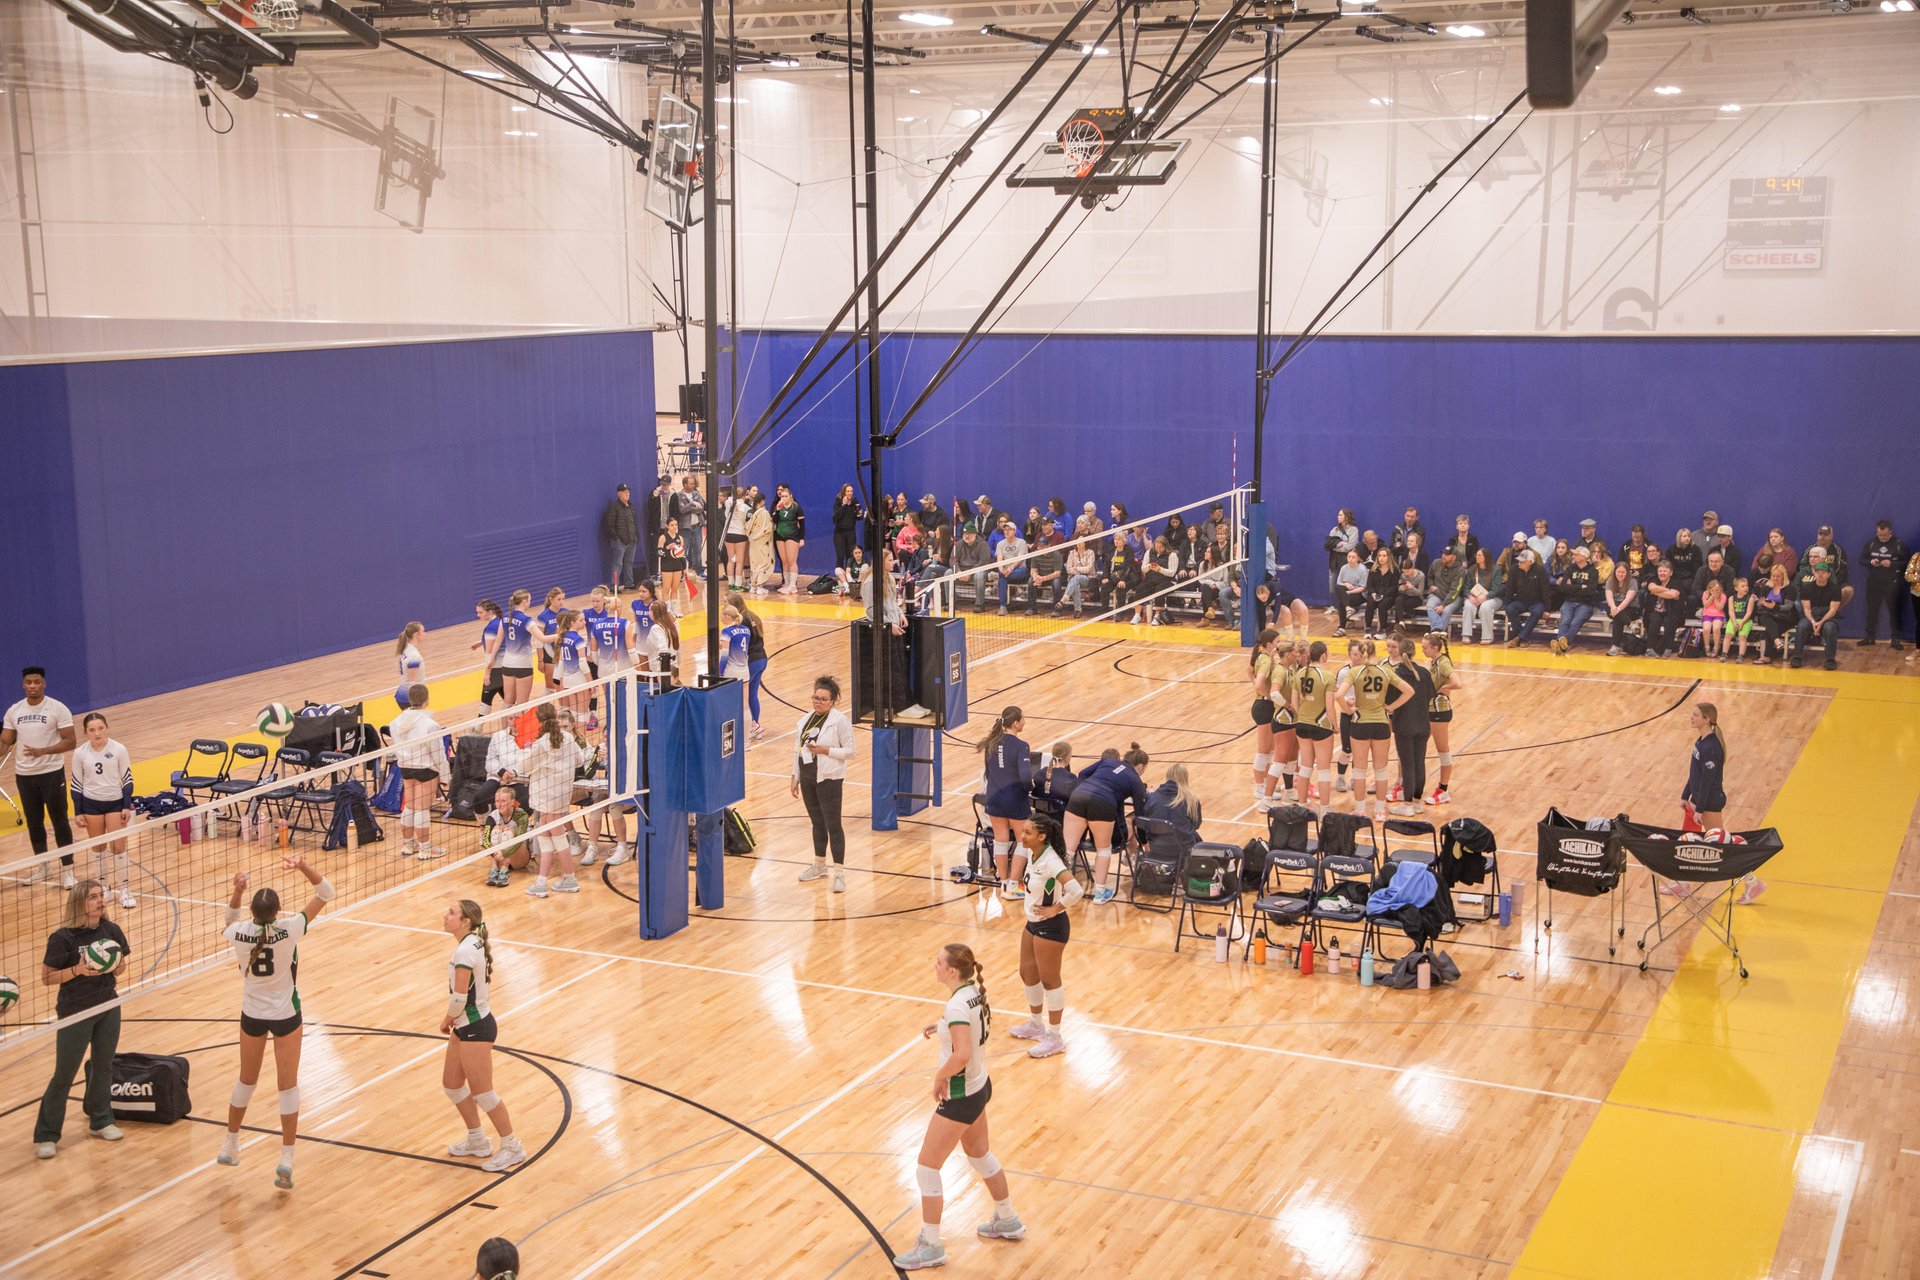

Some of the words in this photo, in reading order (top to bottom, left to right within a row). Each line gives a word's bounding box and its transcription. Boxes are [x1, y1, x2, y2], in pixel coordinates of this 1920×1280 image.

[1766, 177, 1801, 192] 9:44
[1733, 196, 1754, 204] HOME
[1798, 194, 1822, 203] GUEST
[1728, 252, 1817, 265] SCHEELS
[783, 510, 789, 518] 7
[642, 617, 649, 627] 6
[508, 626, 516, 640] 8
[602, 630, 613, 646] 5
[740, 636, 748, 652] 4
[1362, 675, 1384, 692] 26
[17, 714, 48, 725] FREEZE
[94, 762, 103, 775] 3
[1560, 839, 1602, 855] TACHIKARA
[1675, 846, 1721, 860] TACHIKARA
[251, 947, 275, 977] 8
[111, 1081, 153, 1097] olten
